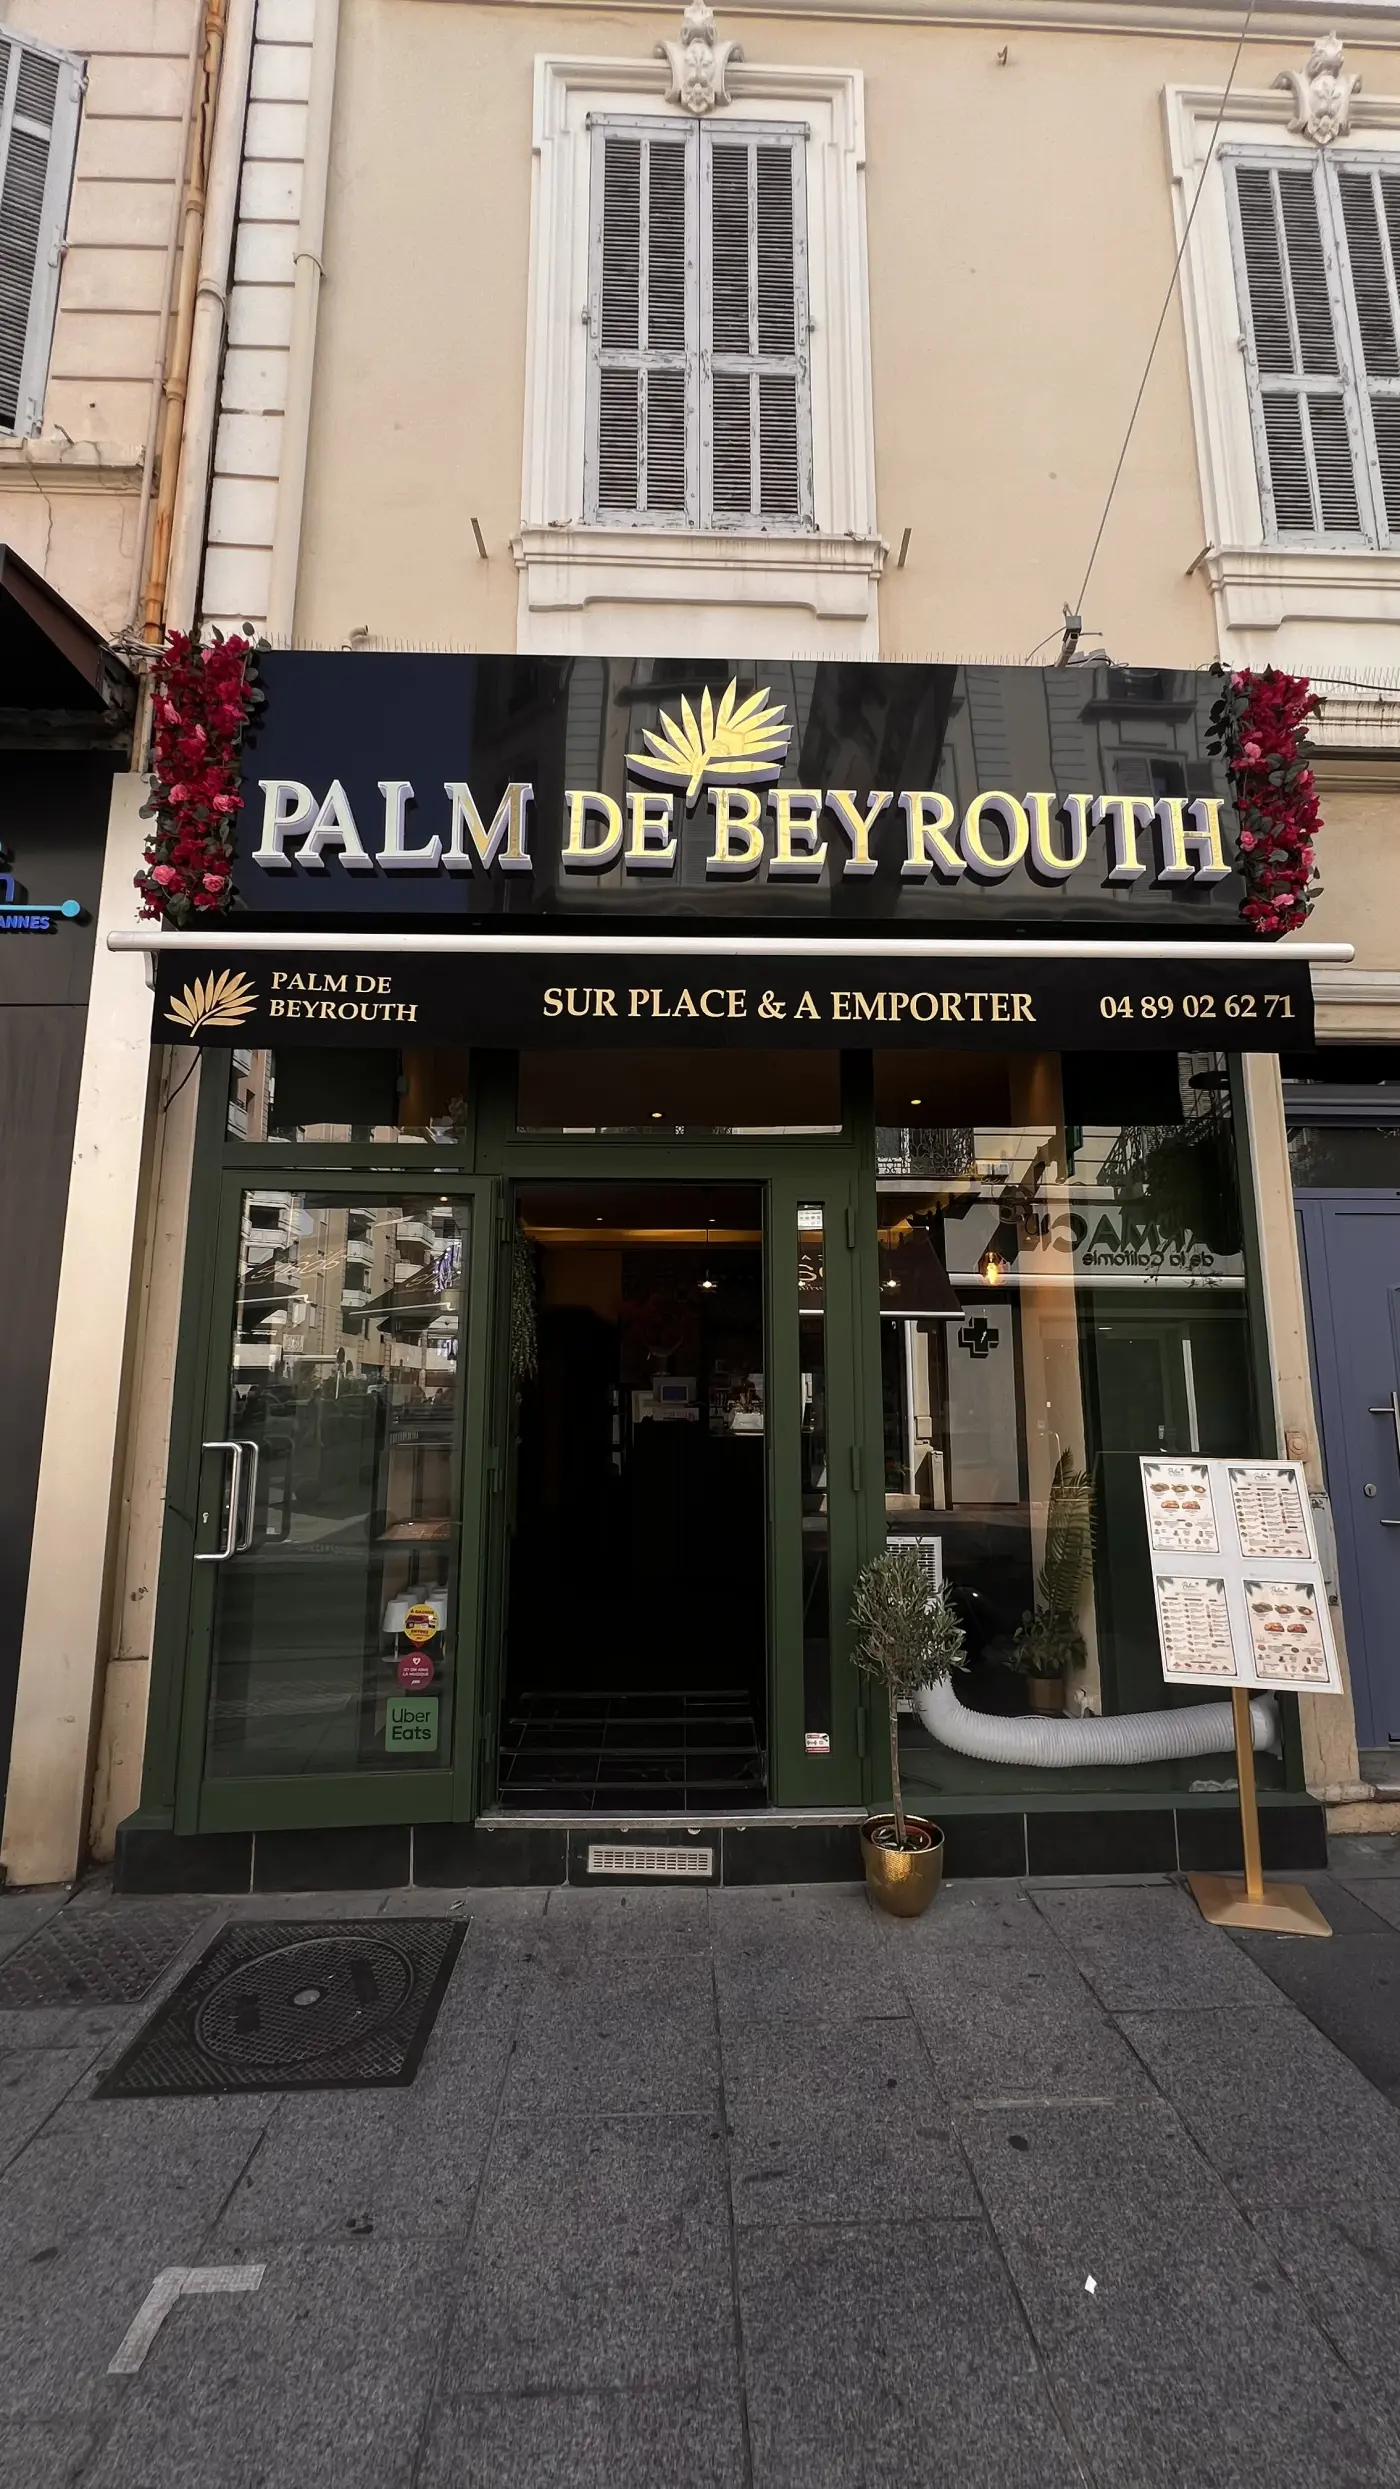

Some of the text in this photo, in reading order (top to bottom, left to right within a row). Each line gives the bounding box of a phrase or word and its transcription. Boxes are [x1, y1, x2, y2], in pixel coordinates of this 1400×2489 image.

[252, 779, 1232, 882] PALM DE BEYROUTH
[271, 972, 392, 994] PALM DE
[270, 999, 418, 1023] BEYROUTH
[543, 987, 1037, 1022] SUR PLACE & A EMPORTER
[1099, 994, 1296, 1019] 04 89 02 62 71
[392, 1708, 432, 1723] Uber
[391, 1725, 432, 1741] Eats
